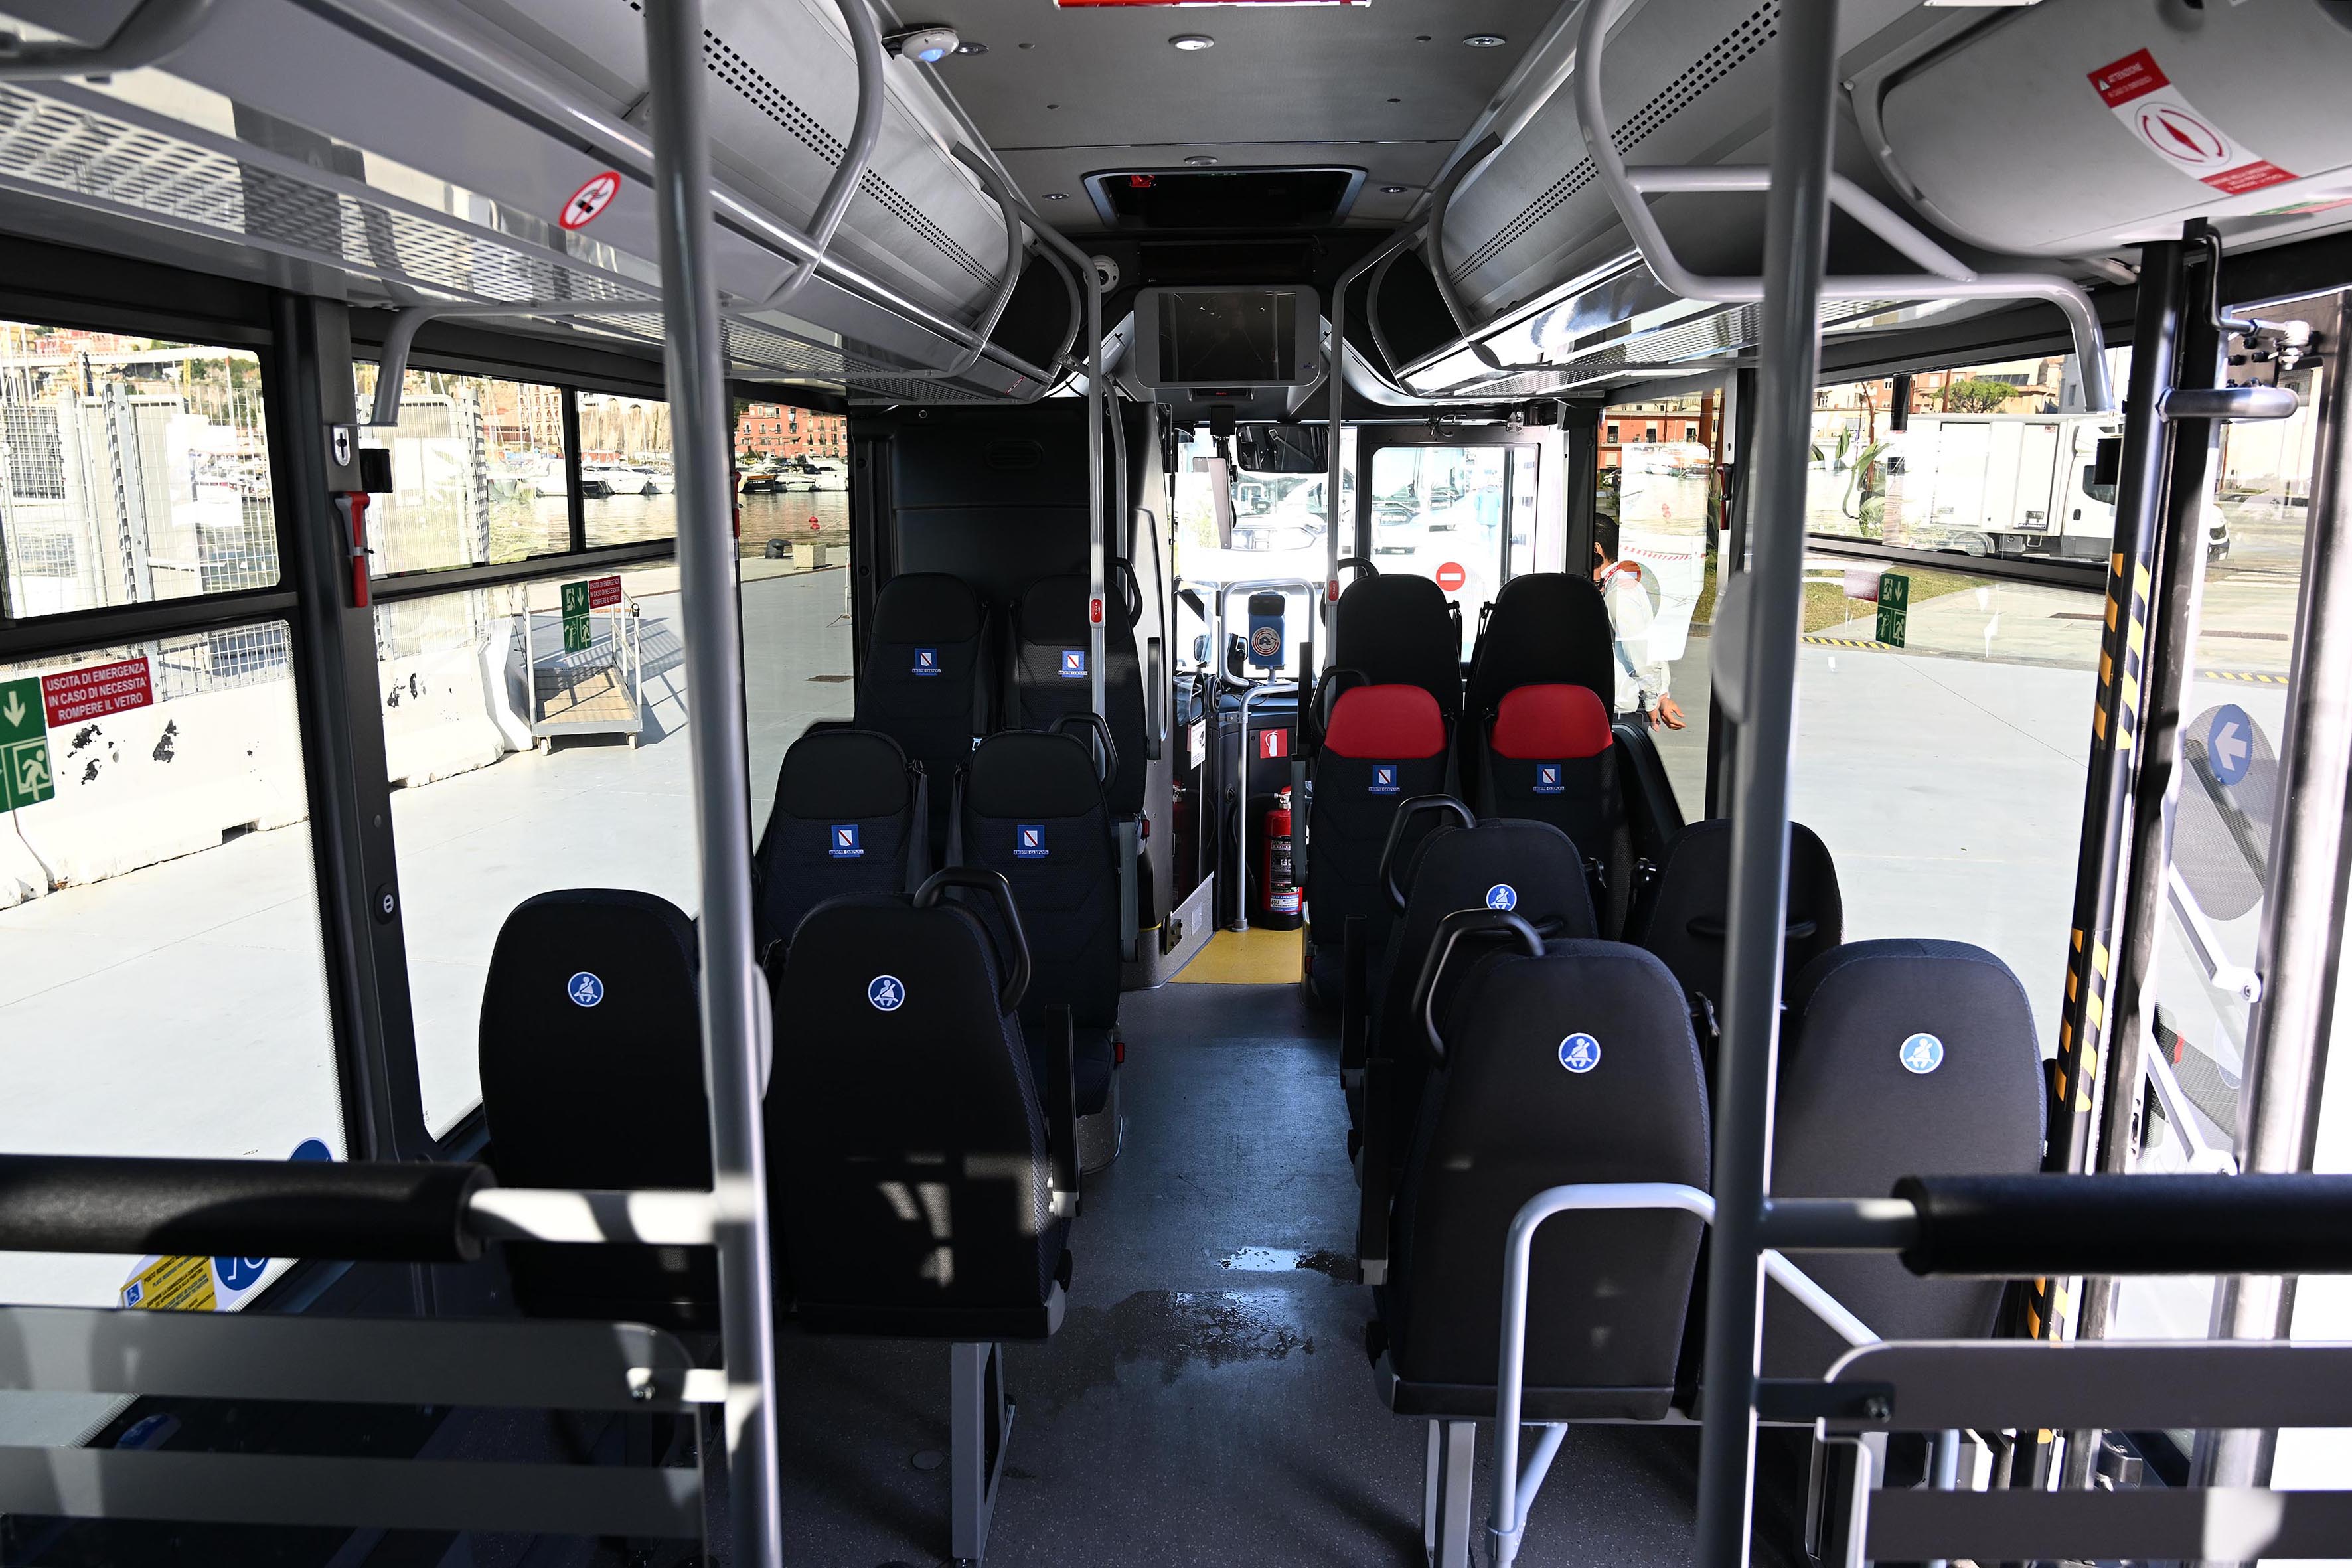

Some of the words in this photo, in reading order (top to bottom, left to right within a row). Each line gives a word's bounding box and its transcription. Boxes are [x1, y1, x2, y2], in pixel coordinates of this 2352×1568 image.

[46, 676, 80, 691] USCITA
[82, 673, 91, 684] DI
[93, 663, 146, 682] EMERGENZA
[49, 696, 58, 707] IN
[61, 689, 86, 704] CASO
[88, 687, 98, 698] DI
[58, 702, 104, 721] ROMPERE
[105, 700, 114, 711] IL
[115, 692, 143, 708] VETRO
